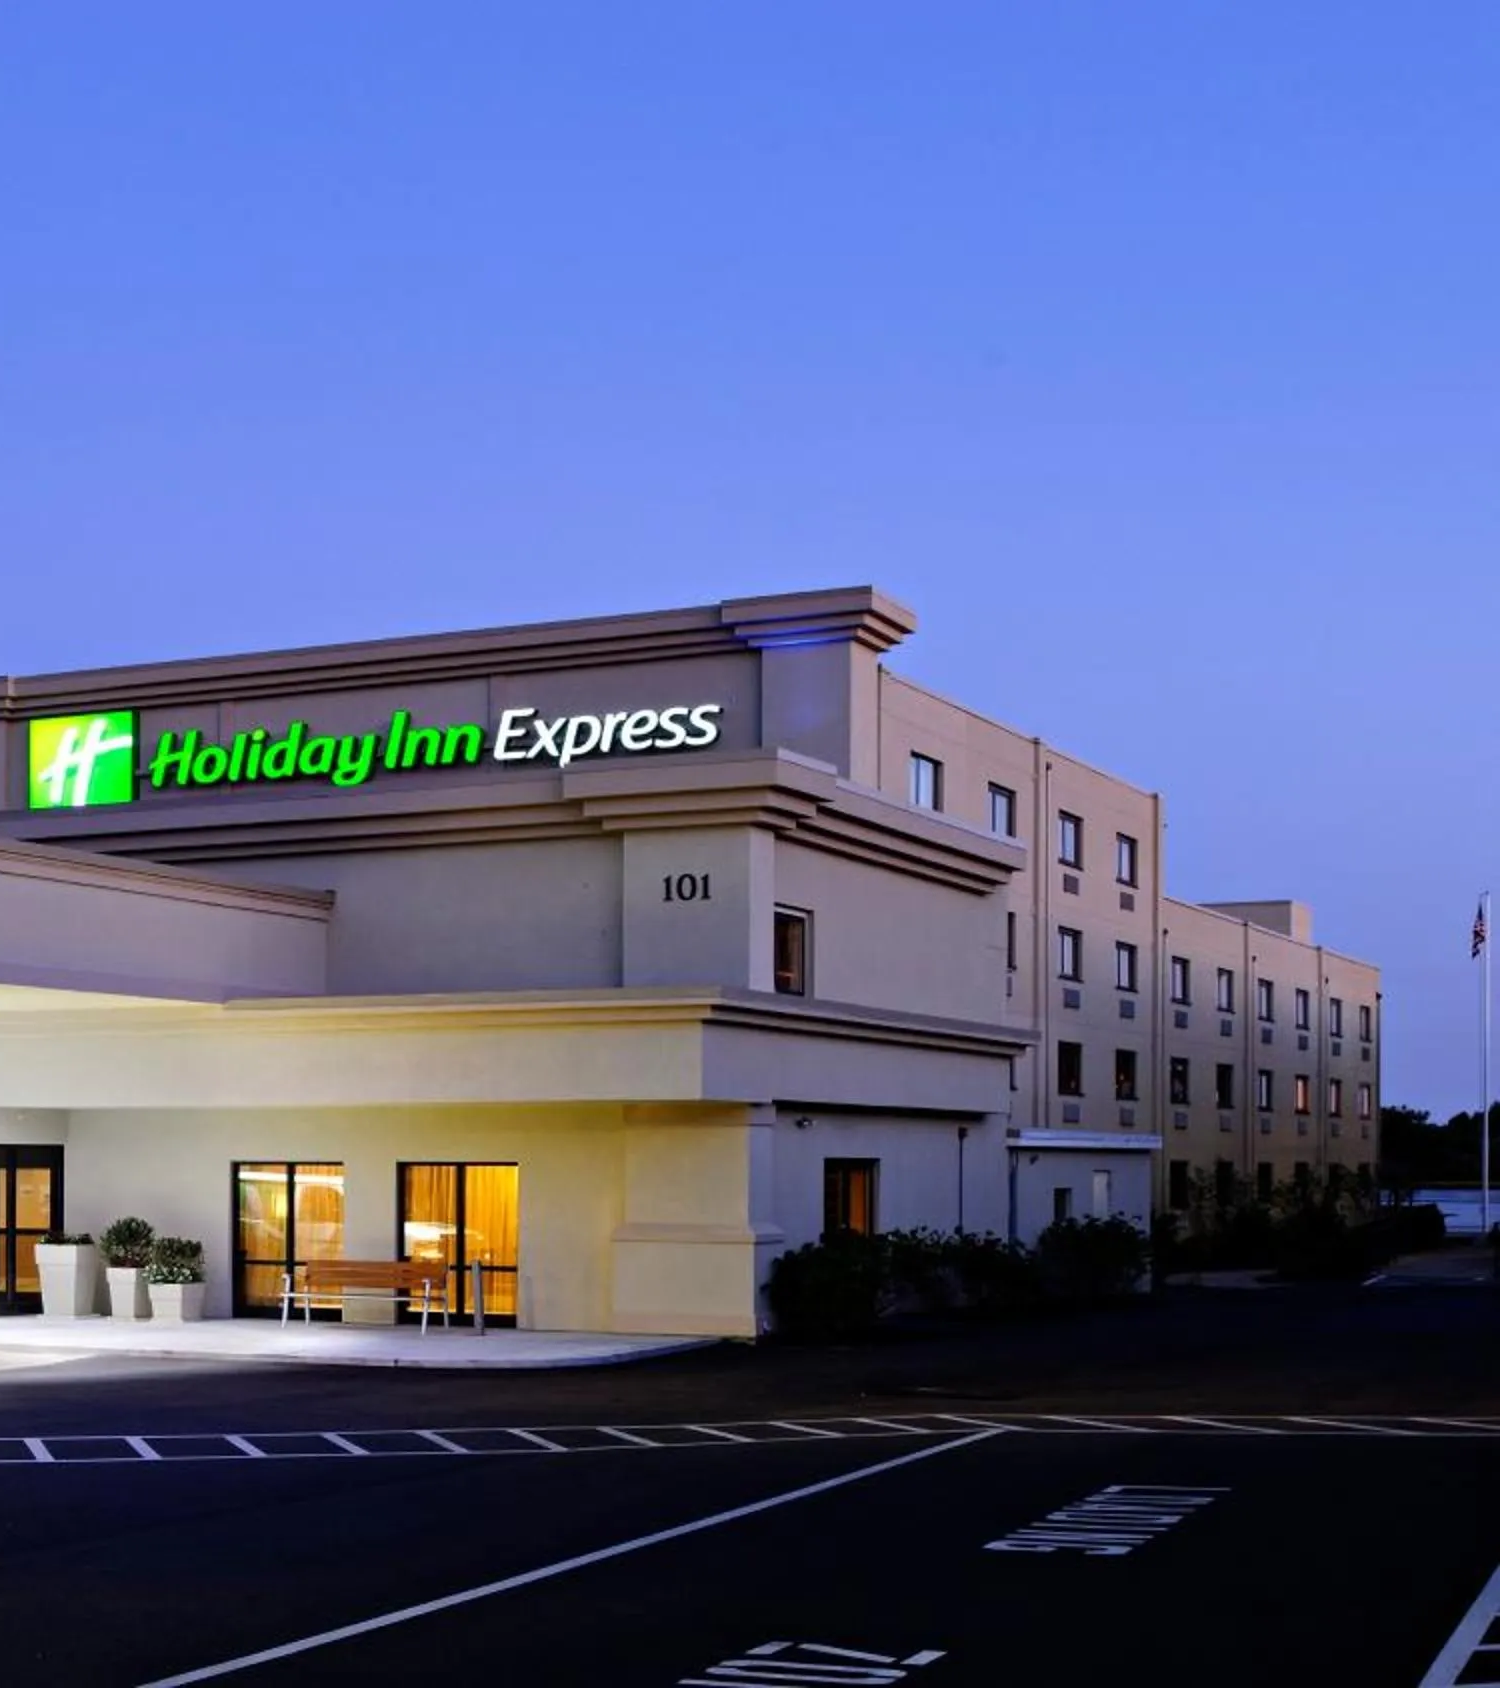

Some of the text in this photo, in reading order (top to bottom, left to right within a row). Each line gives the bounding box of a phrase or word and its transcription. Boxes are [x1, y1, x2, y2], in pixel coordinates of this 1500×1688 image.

[149, 704, 721, 787] Holiday Inn Express
[662, 873, 712, 902] 101
